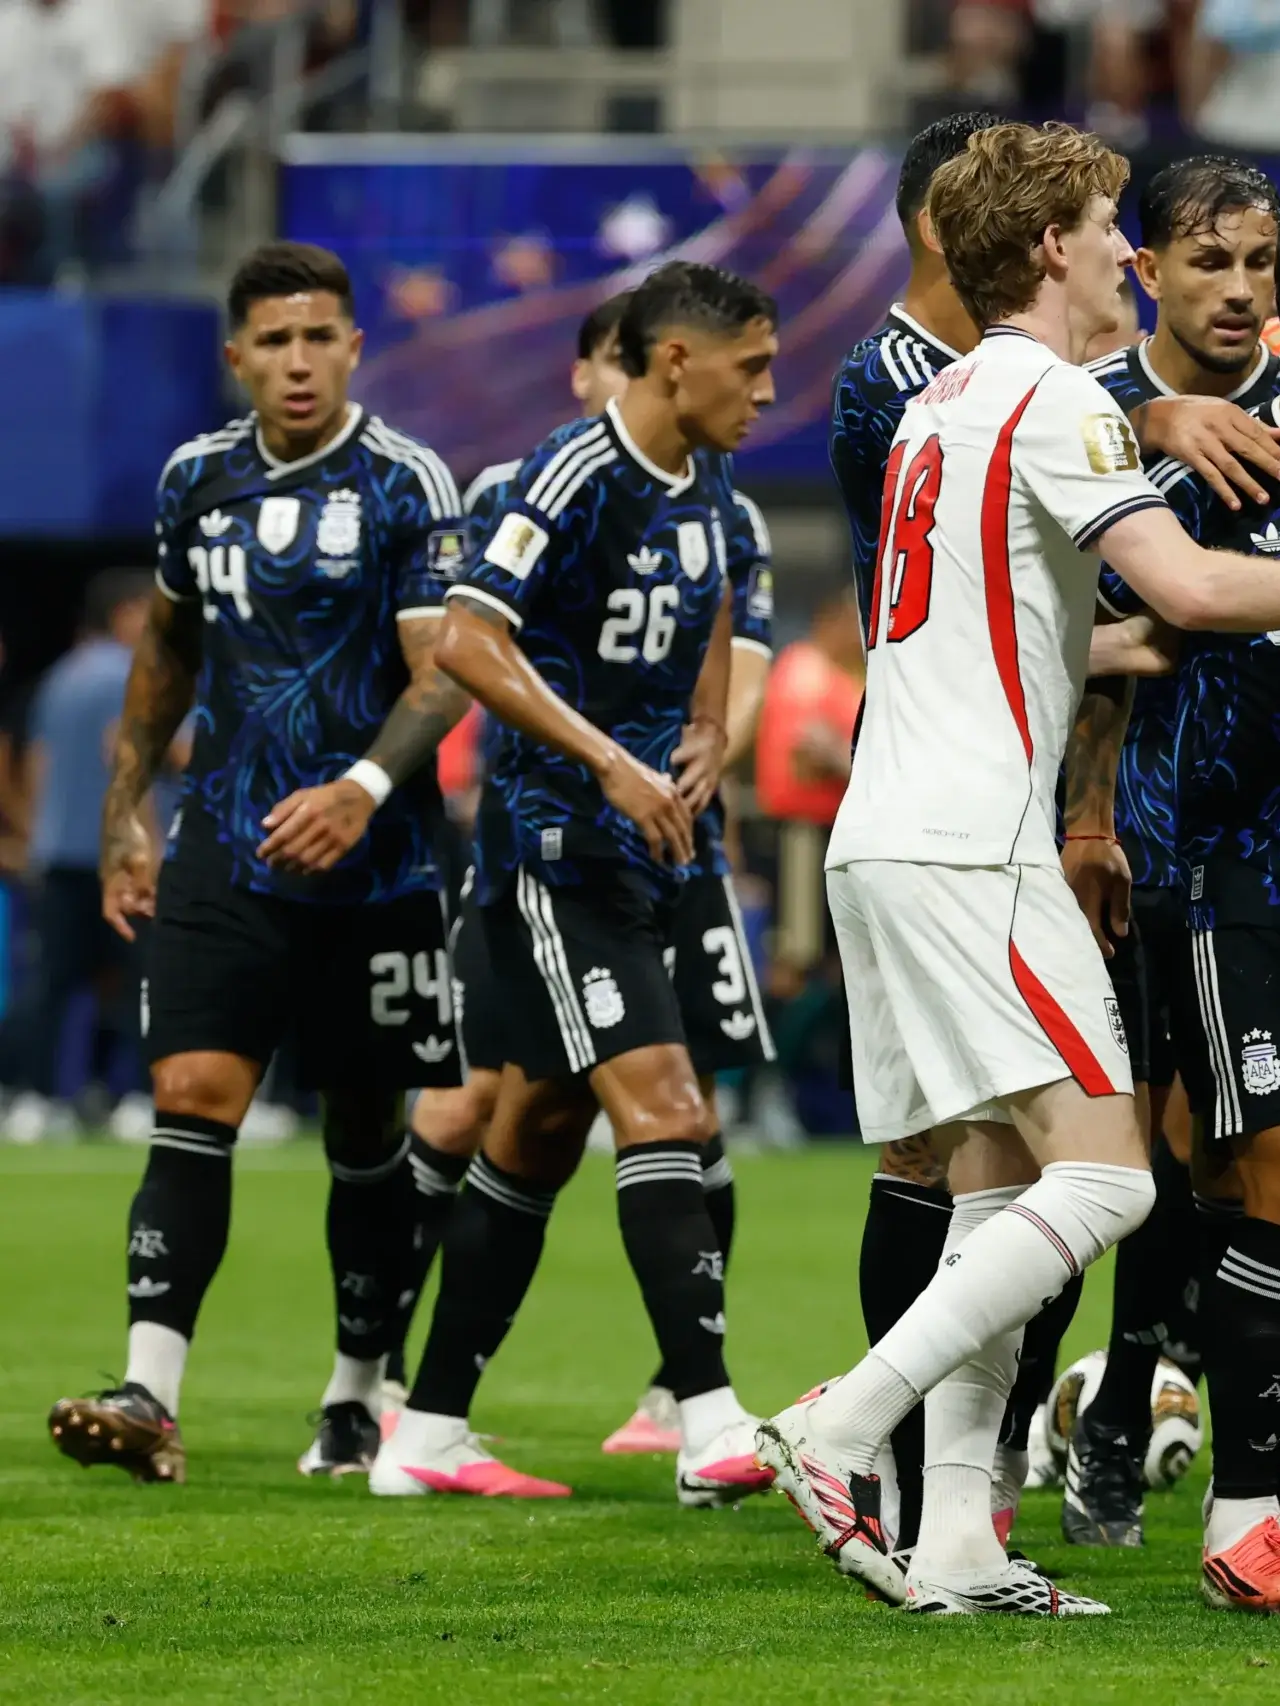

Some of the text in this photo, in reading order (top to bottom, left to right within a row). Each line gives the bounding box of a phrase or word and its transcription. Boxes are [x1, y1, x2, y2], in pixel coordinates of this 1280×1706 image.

[597, 584, 680, 664] 26
[369, 948, 452, 1026] 24
[702, 925, 747, 1005] 3
